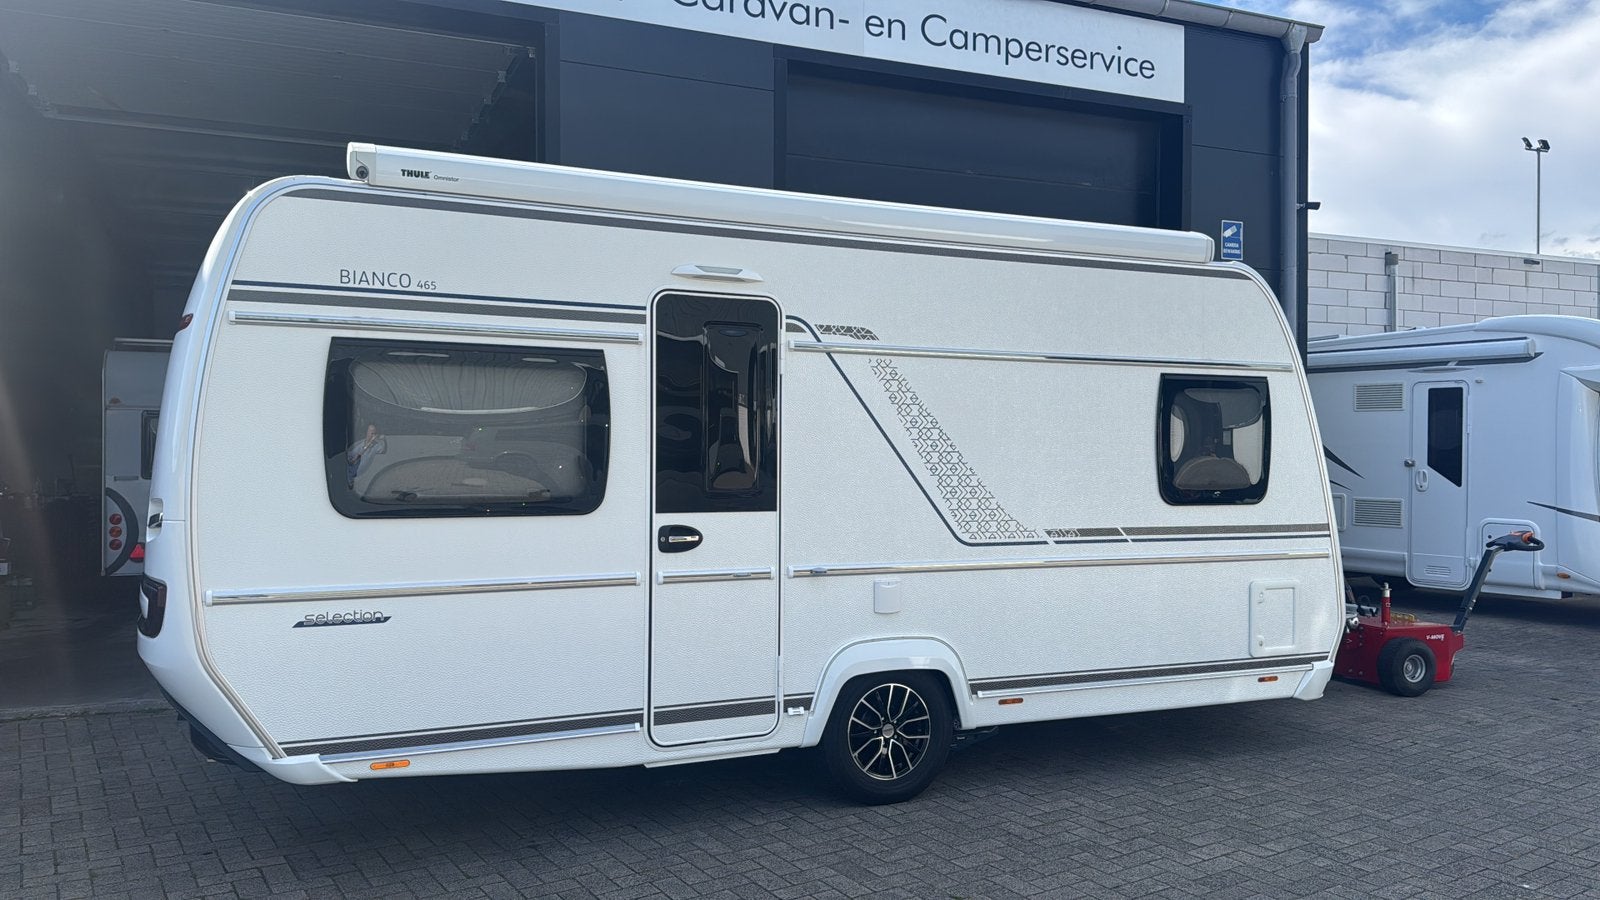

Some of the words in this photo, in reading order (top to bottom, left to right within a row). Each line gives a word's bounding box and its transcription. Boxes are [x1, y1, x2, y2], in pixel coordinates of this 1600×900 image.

[673, 0, 850, 30] aravan-
[864, 14, 906, 41] en
[920, 13, 1156, 80] Camperservice
[400, 168, 431, 179] THULE
[433, 174, 460, 182] Omnistor
[340, 269, 412, 288] BIANCO
[416, 280, 437, 290] 465
[303, 609, 384, 626] selection
